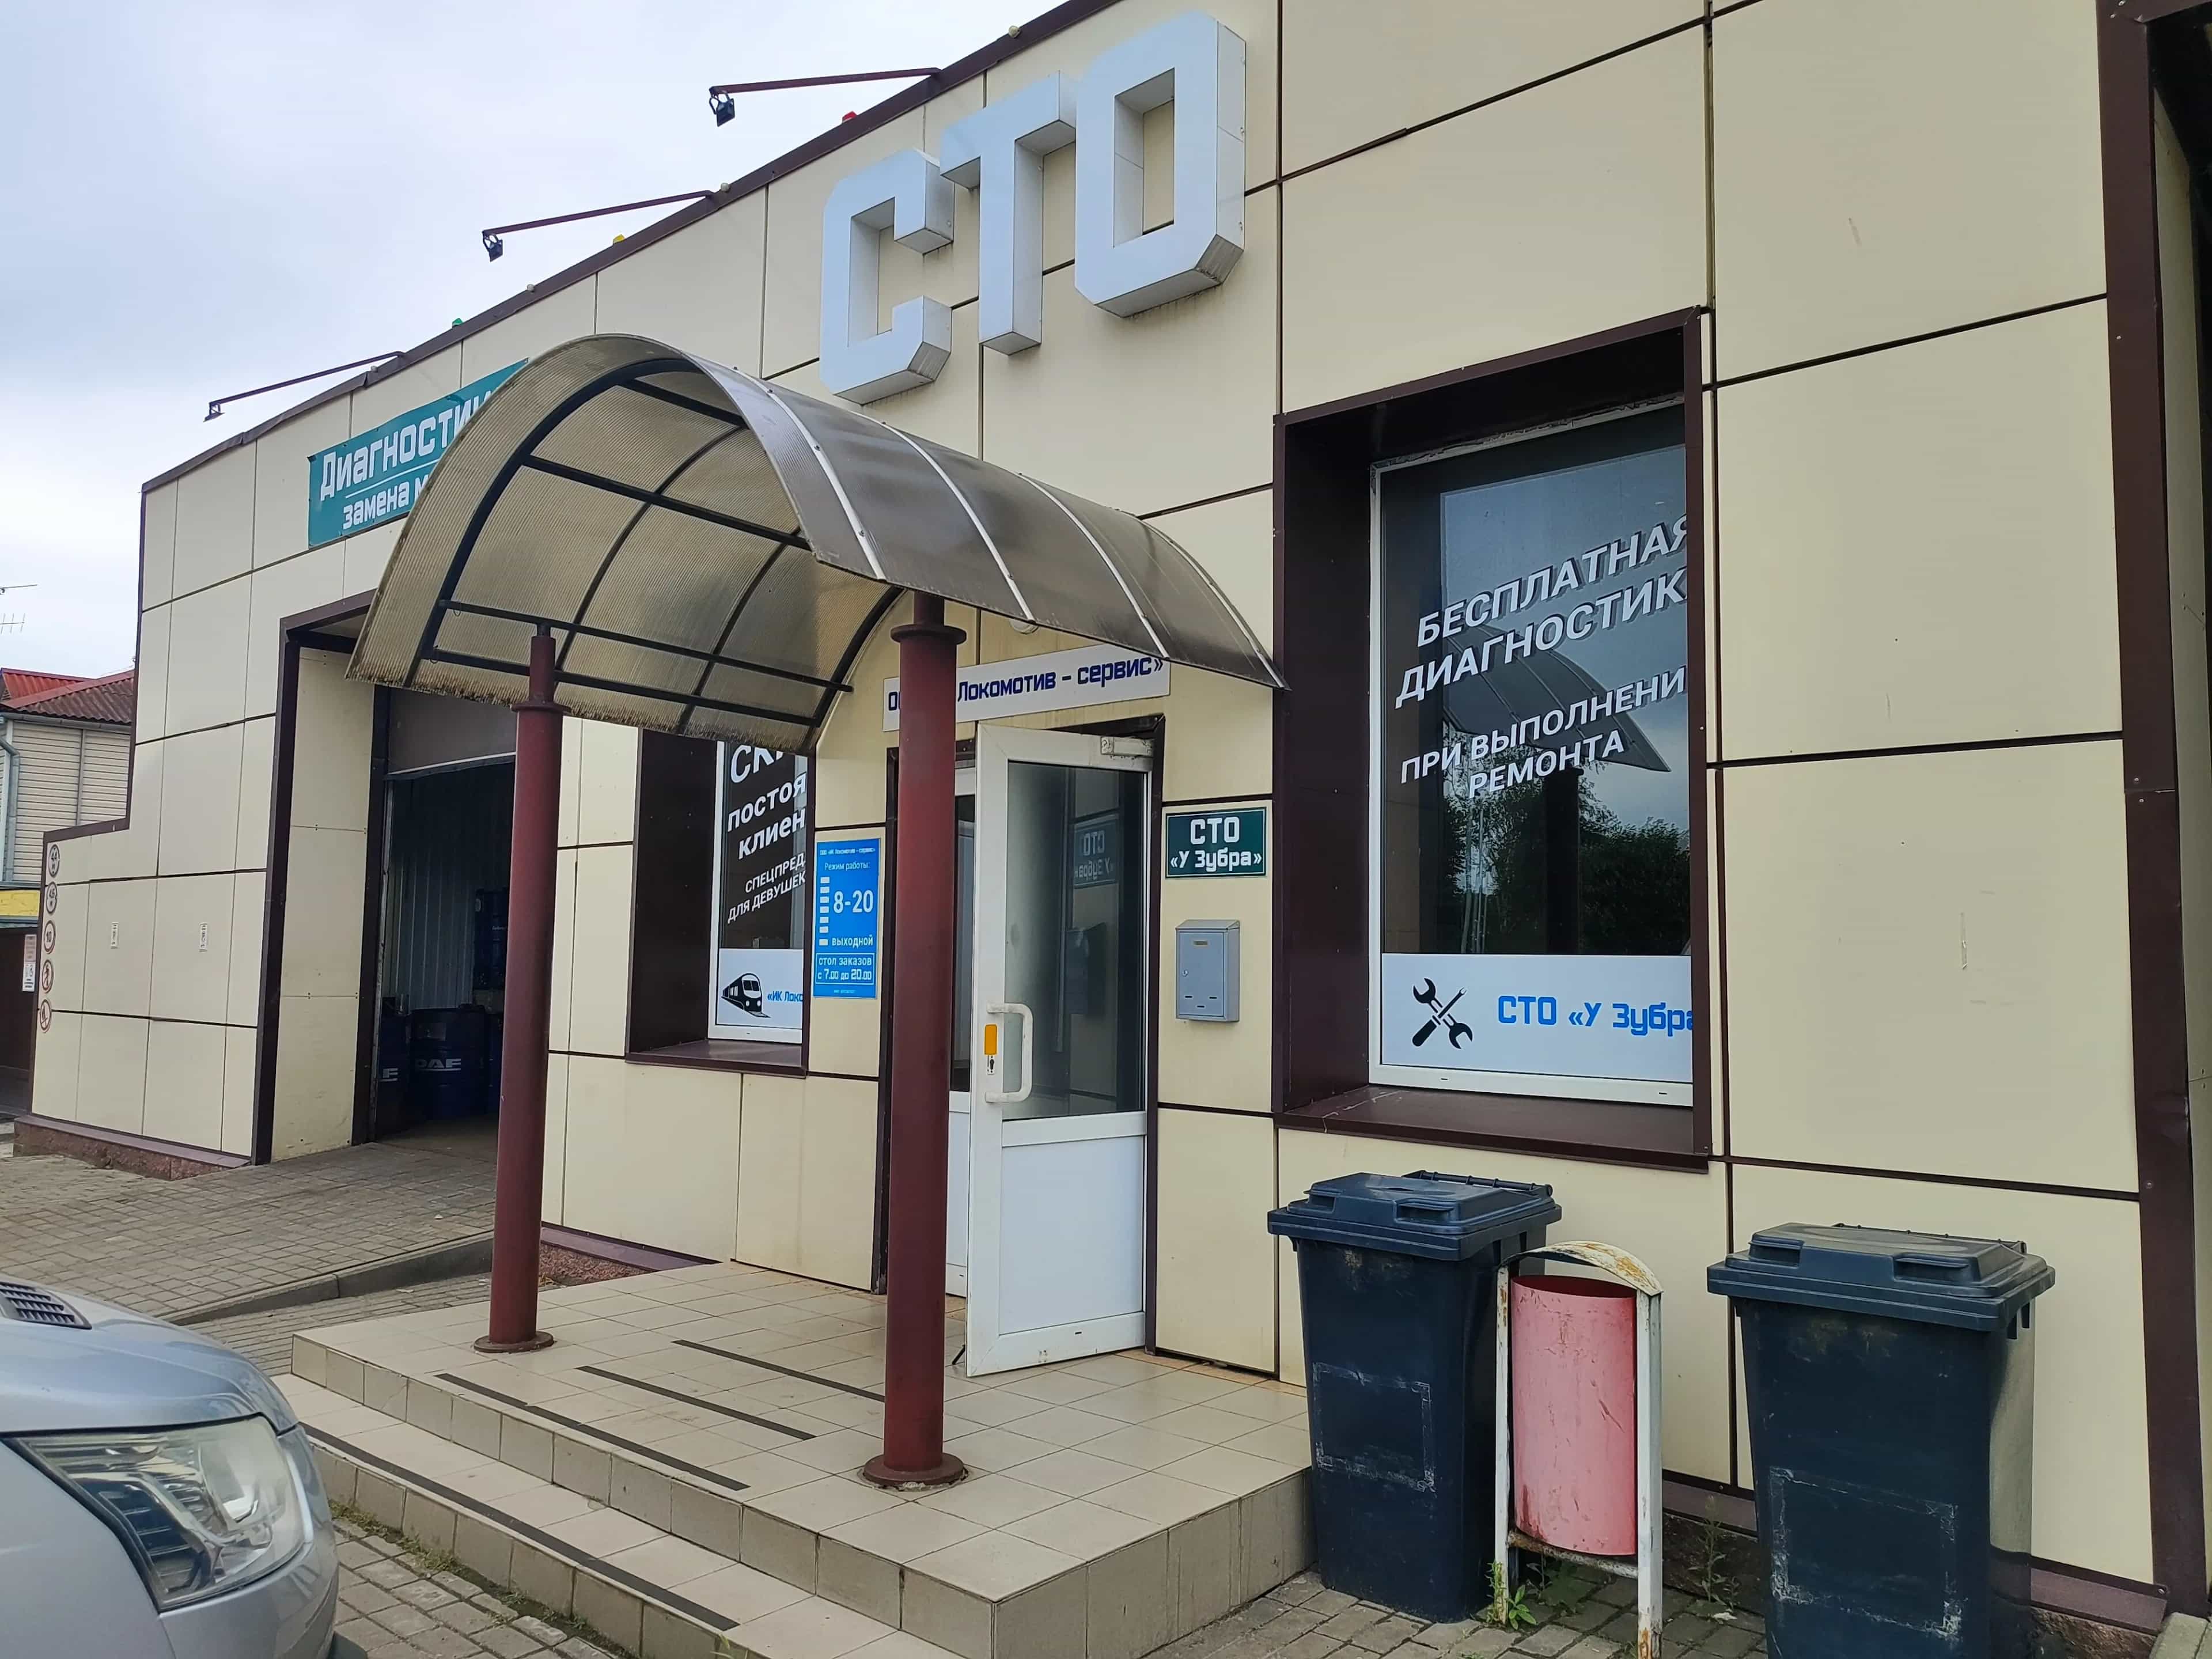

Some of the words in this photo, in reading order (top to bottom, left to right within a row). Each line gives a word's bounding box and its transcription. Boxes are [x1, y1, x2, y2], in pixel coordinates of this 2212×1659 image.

[819, 10, 1246, 404] СТО
[320, 390, 491, 502] Диагности
[343, 481, 410, 530] замена
[1417, 514, 1687, 647] БЕСПЛАТНАЯ
[1395, 568, 1687, 709] ДИАГНОСТИК
[957, 671, 1056, 702] Локомотив
[1077, 657, 1164, 687] сервис»
[1401, 742, 1461, 783] ПРИ
[1470, 666, 1687, 761] ВЫПОЛНЕНИ
[1469, 730, 1624, 798] РЕМОНТА
[1190, 816, 1240, 844] СТО
[745, 852, 806, 893] СПЕЦПРЕД
[1195, 847, 1263, 872] Зубра»
[728, 902, 750, 924] ДЛЯ
[833, 889, 874, 914] 8-20
[838, 957, 872, 965] заказов
[1498, 996, 1557, 1025] СТО
